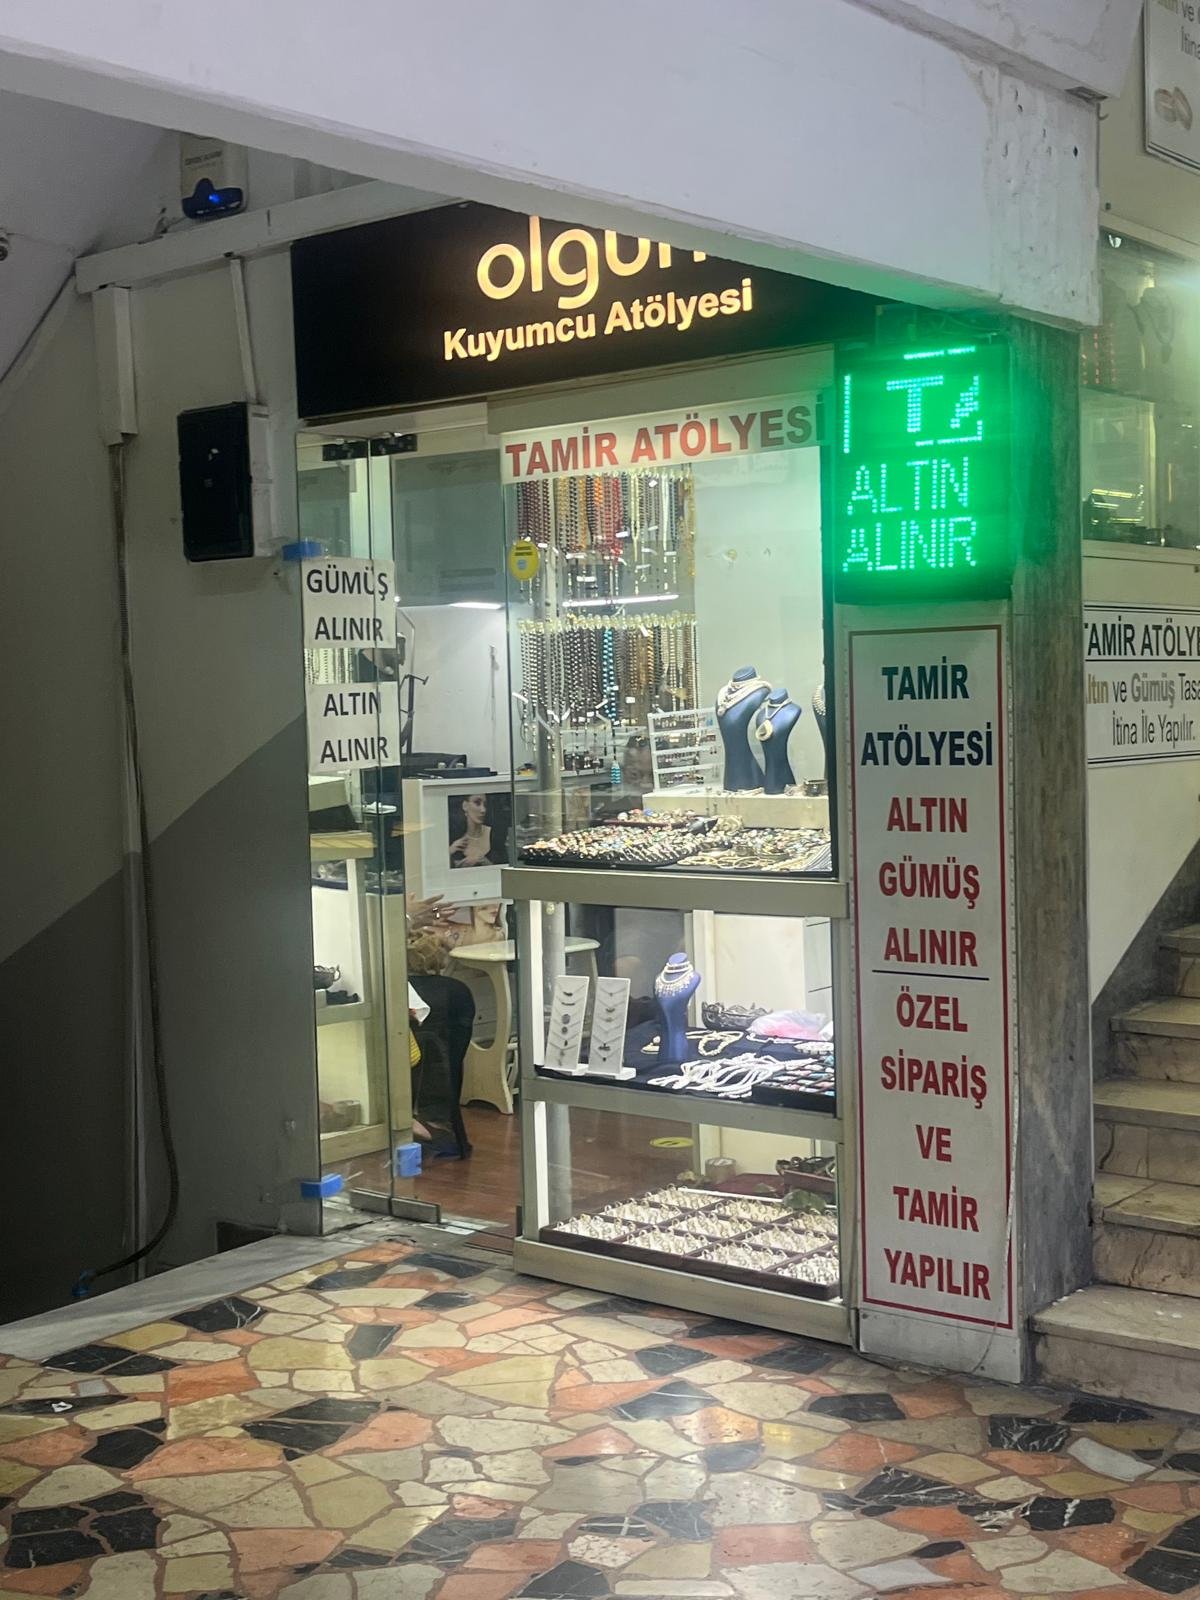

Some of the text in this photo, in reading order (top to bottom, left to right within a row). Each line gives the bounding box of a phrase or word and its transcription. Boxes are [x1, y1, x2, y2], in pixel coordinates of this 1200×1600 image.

[477, 215, 706, 309] olgu
[444, 278, 753, 361] Kuyumcu Atölyesi
[506, 427, 618, 477] TAMİR
[847, 456, 969, 515] ALTIN
[842, 516, 977, 571] ALINIR
[306, 564, 388, 600] GÜMÜŞ
[315, 616, 383, 641] ALINIR
[882, 656, 969, 700] TAMİR
[1086, 673, 1108, 704] ltın
[1112, 681, 1127, 702] ve
[1131, 672, 1176, 708] Gümüş
[323, 692, 381, 717] ALTIN
[320, 736, 389, 763] ALINIR
[861, 721, 993, 766] ATÖLYESİ
[1113, 709, 1196, 748] İtina İle Yapılır.
[887, 797, 968, 833] ALTIN
[879, 856, 980, 909] GÜMÜŞ
[884, 927, 978, 967] ALINIR
[896, 986, 968, 1032] ÖZEL
[881, 1049, 987, 1109] SİPARİŞ
[916, 1124, 952, 1162] VE
[893, 1186, 979, 1232] TAMİR
[884, 1248, 991, 1300] YAPILIR
